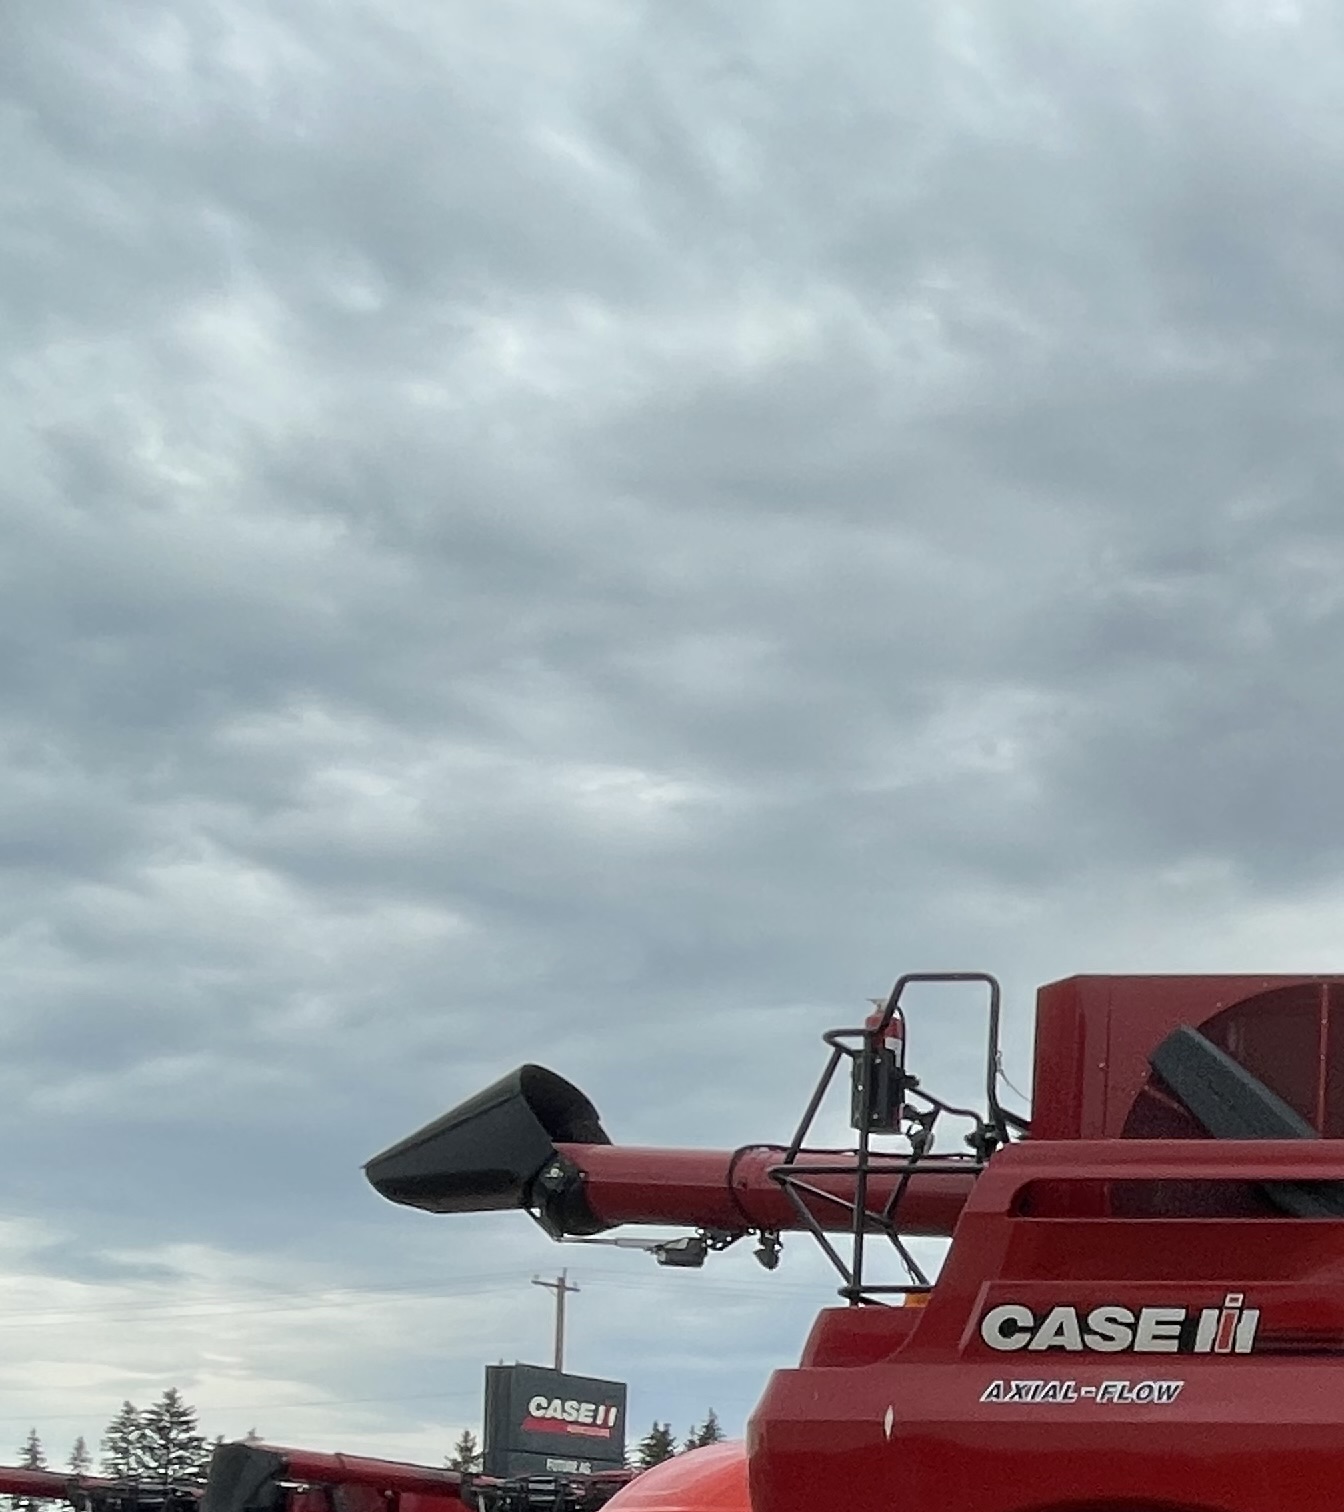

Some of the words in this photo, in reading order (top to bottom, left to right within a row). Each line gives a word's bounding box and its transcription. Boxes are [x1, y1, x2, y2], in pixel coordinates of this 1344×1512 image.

[981, 1304, 1186, 1352] CASE
[980, 1380, 1184, 1403] AXIAL-FLOW
[528, 1395, 596, 1424] CASE
